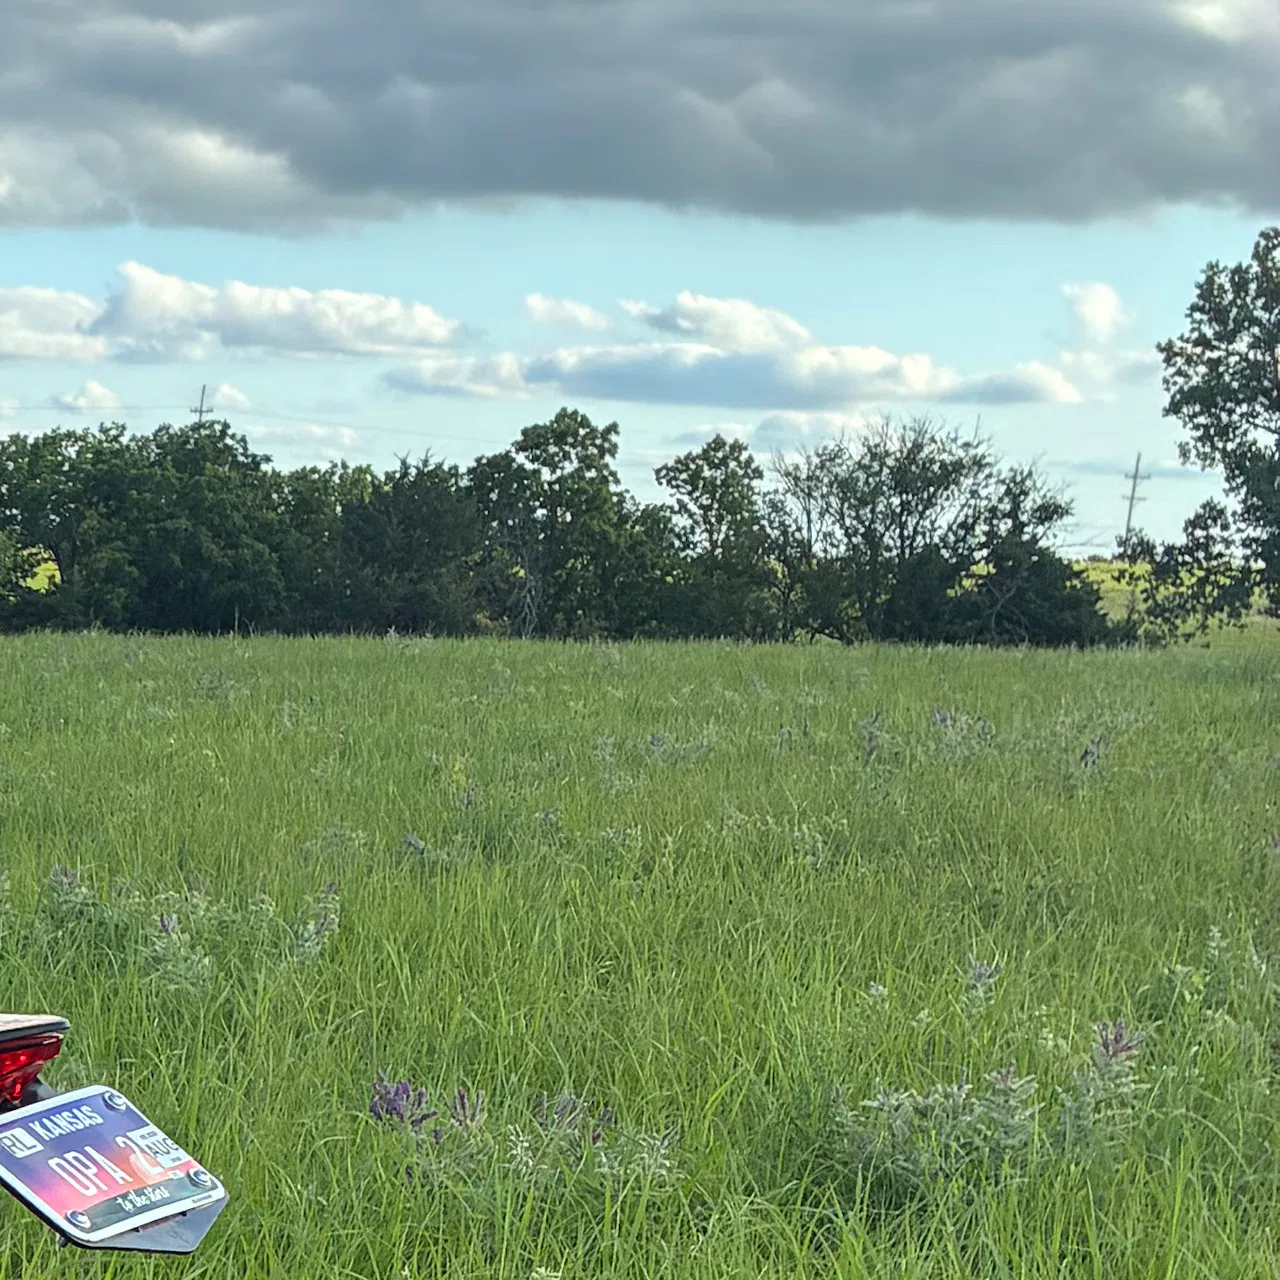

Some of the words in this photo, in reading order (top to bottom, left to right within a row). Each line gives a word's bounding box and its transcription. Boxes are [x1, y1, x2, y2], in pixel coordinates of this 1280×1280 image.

[28, 1105, 104, 1141] KANSAS
[145, 1137, 180, 1158] AUG
[47, 1145, 134, 1197] OPA
[127, 1189, 150, 1207] the
